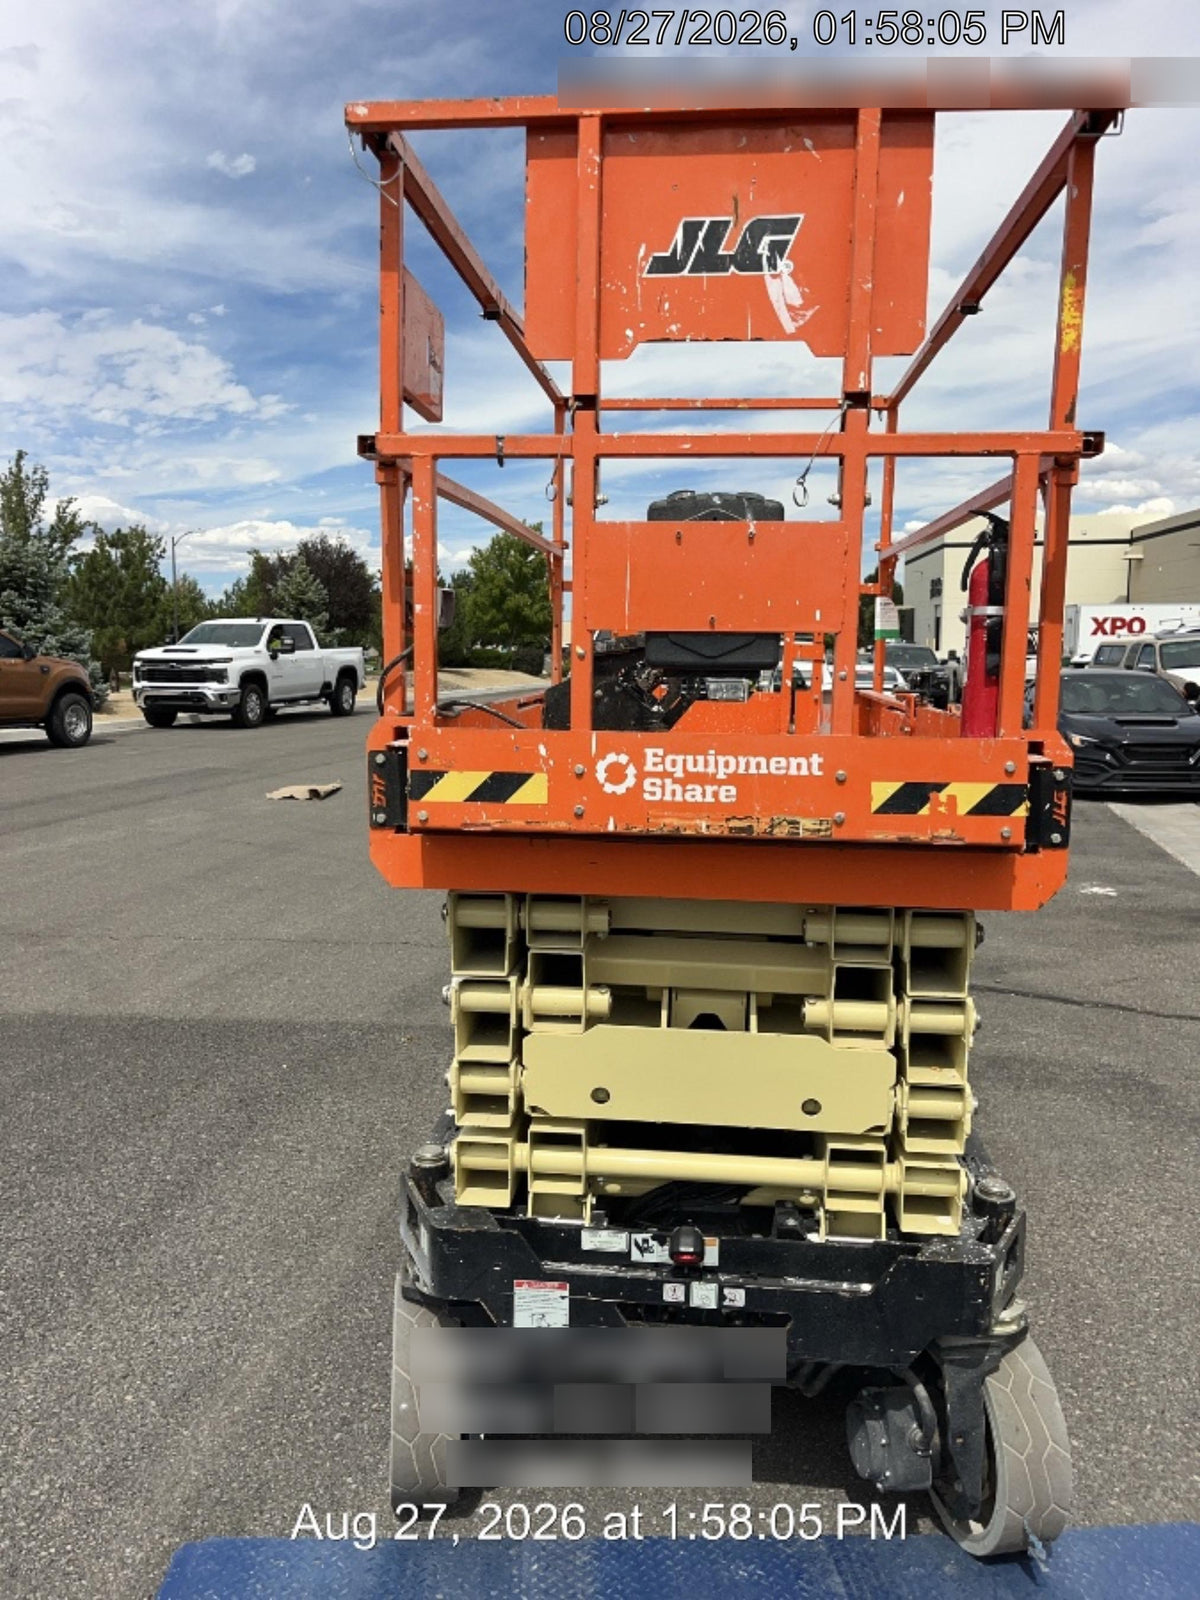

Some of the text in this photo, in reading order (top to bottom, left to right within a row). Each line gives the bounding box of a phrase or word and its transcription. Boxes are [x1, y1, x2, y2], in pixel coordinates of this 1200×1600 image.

[642, 213, 805, 277] JLG
[1090, 616, 1146, 635] XPO
[643, 748, 824, 779] Equipment
[643, 777, 737, 803] Share
